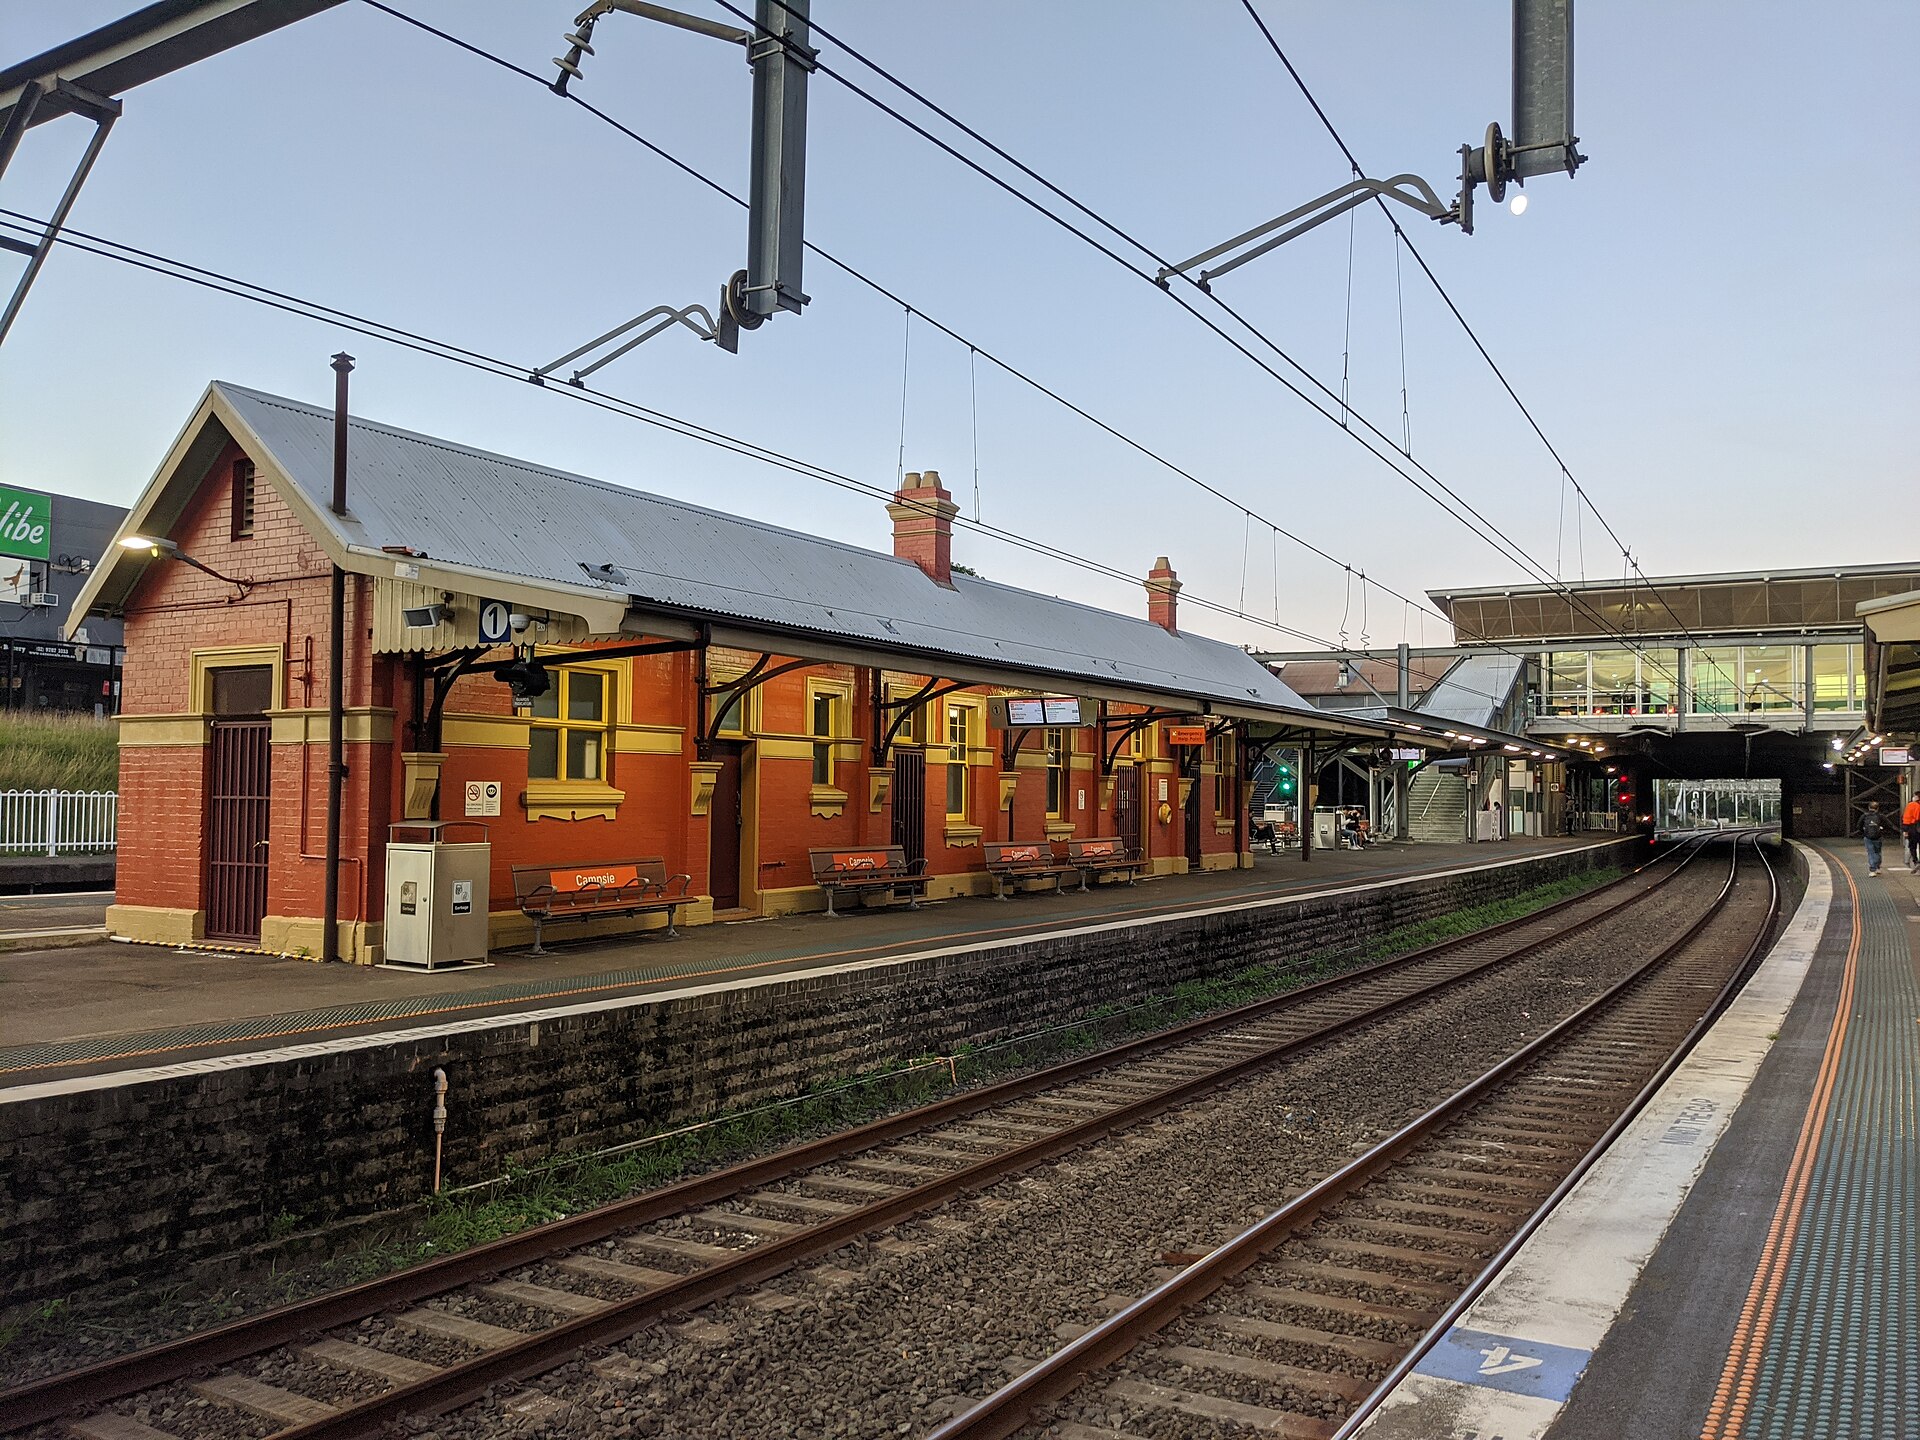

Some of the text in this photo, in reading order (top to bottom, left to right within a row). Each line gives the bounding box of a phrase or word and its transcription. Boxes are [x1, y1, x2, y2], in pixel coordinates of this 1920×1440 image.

[488, 606, 499, 635] 1
[576, 872, 615, 887] Campsie
[1685, 1098, 1720, 1112] GAP
[1673, 1111, 1712, 1126] THE
